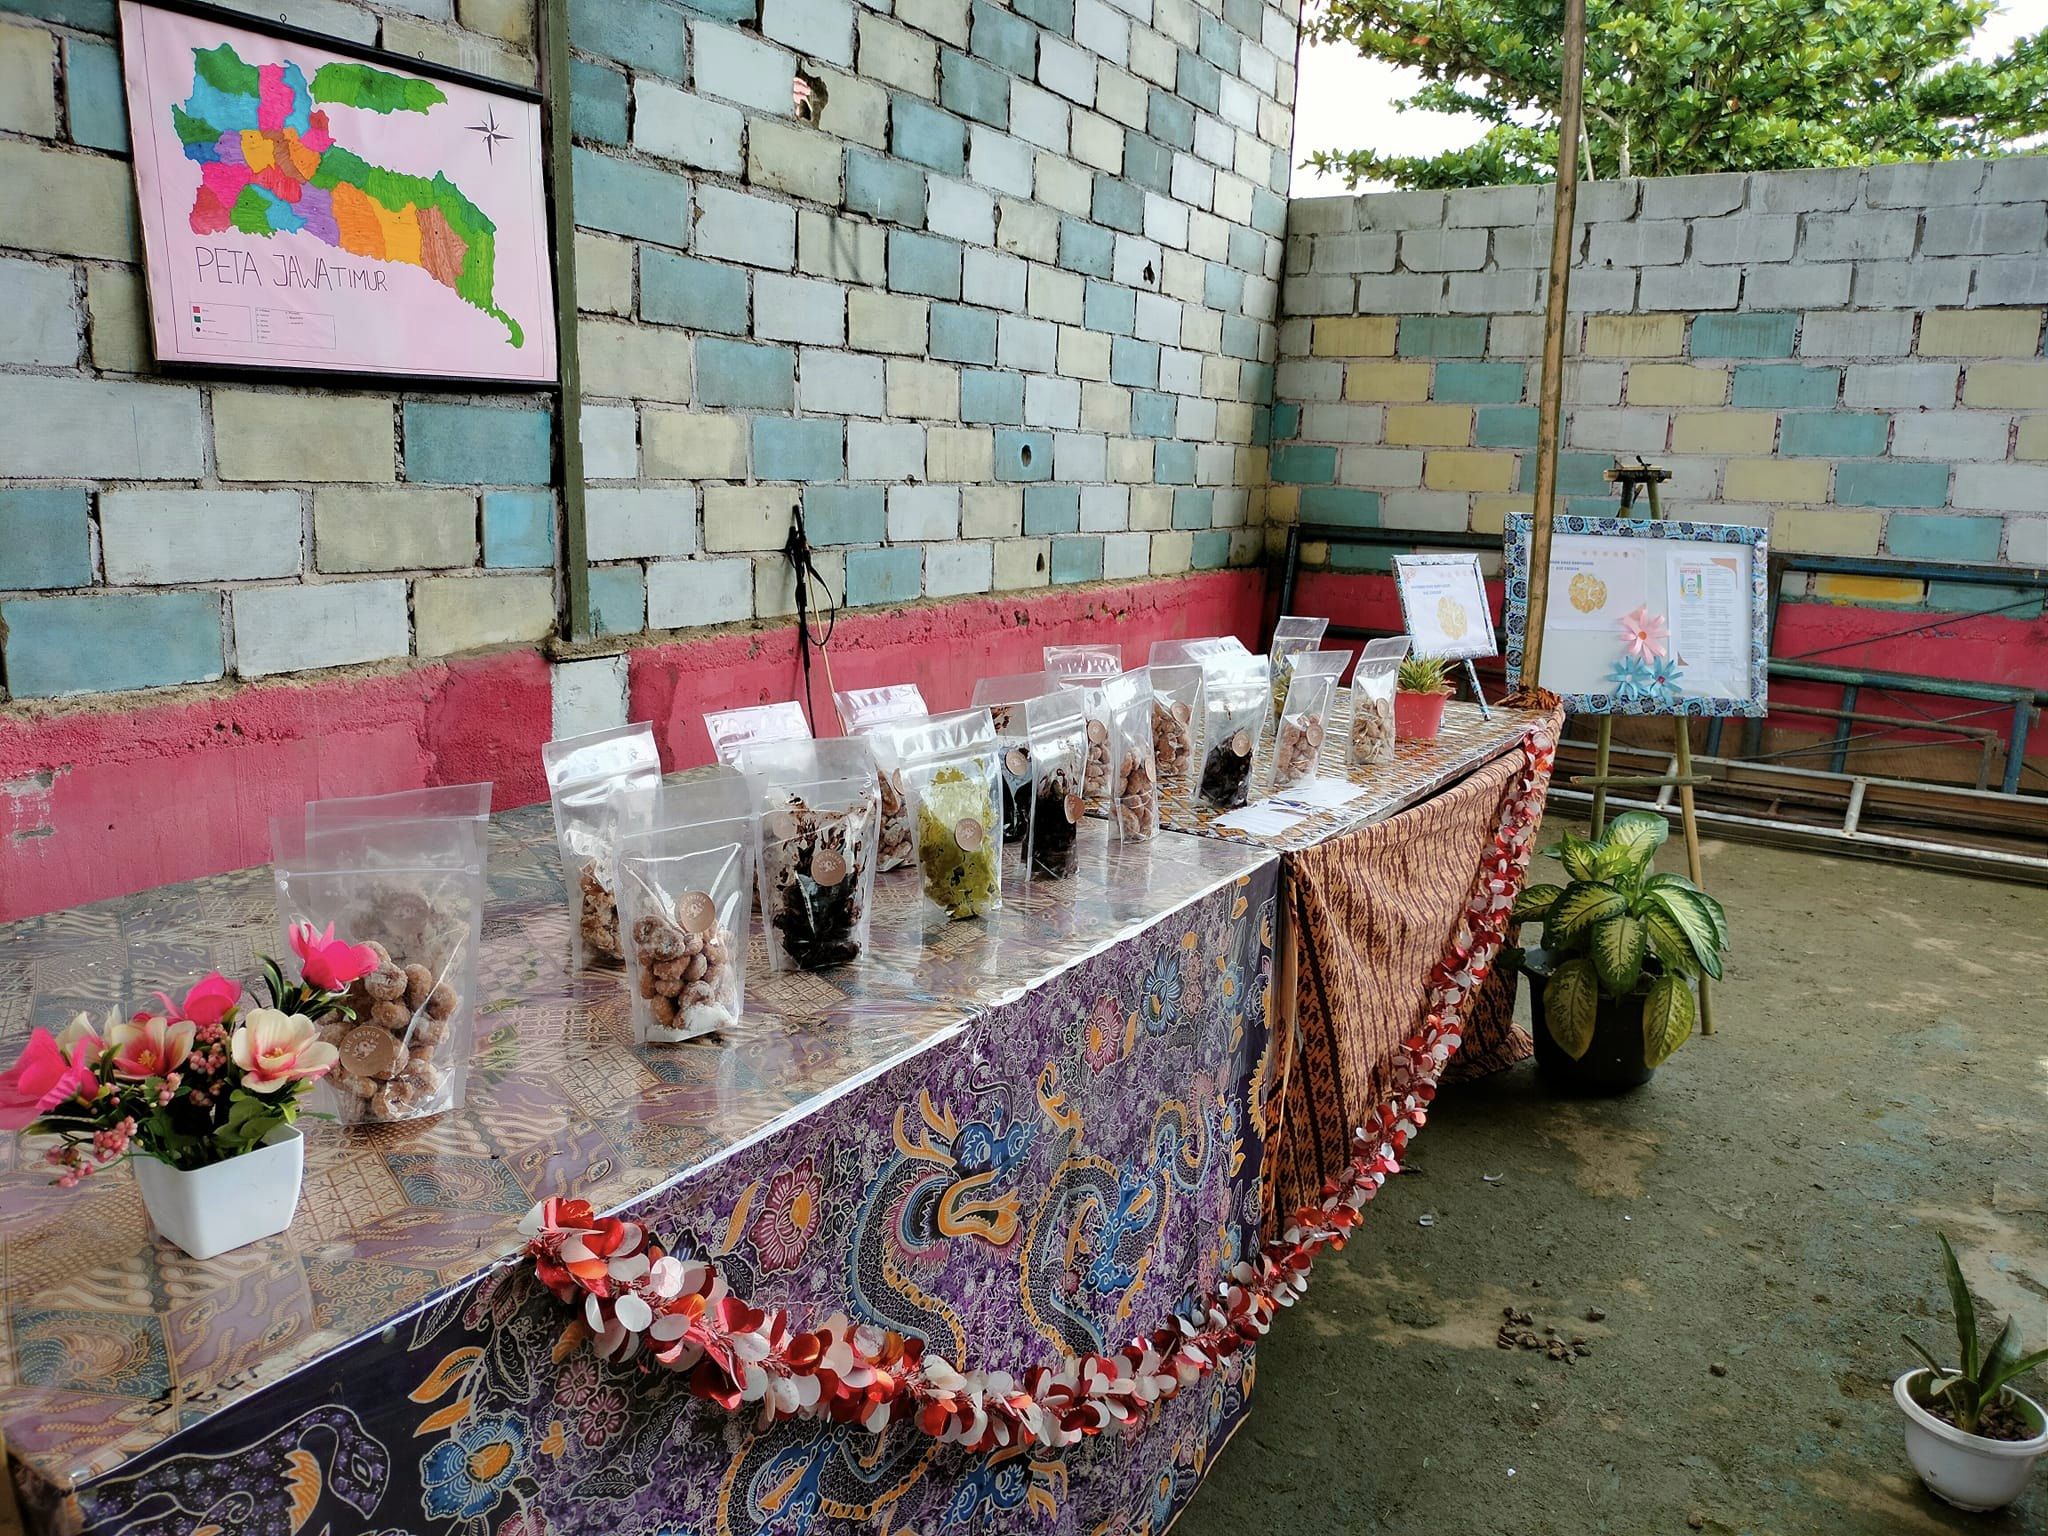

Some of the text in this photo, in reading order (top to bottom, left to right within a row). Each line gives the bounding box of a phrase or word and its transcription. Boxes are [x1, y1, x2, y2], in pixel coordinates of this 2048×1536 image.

[195, 246, 388, 292] PETA JAWA TIMUR
